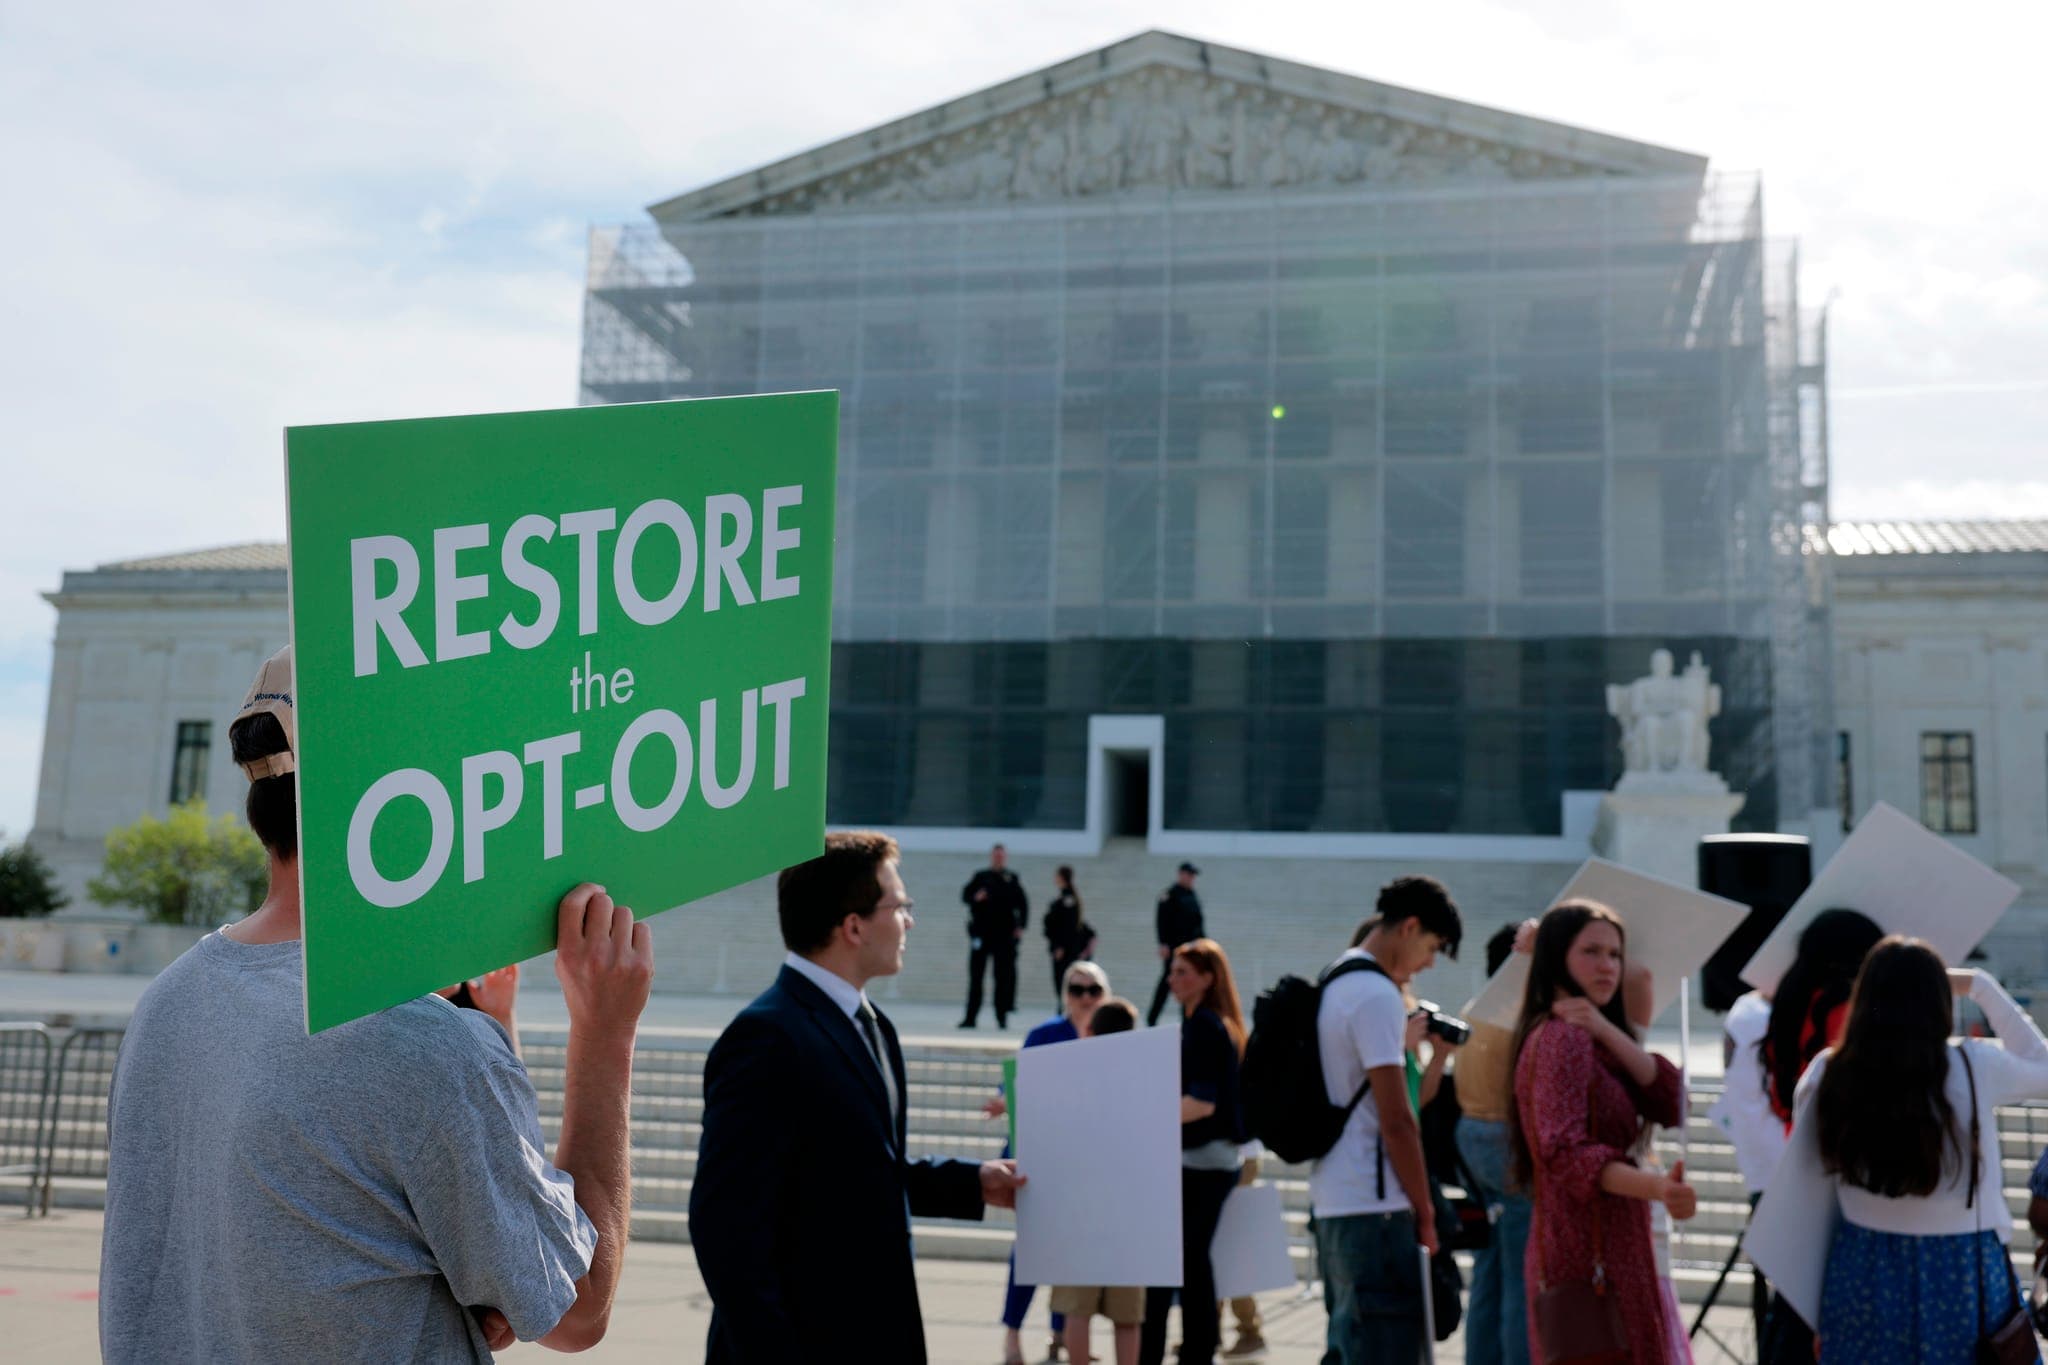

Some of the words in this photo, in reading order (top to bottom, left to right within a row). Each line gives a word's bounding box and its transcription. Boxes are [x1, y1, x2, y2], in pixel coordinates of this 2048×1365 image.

[350, 485, 803, 677] RESTORE
[569, 652, 635, 714] the
[347, 677, 806, 908] OPT-OUT
